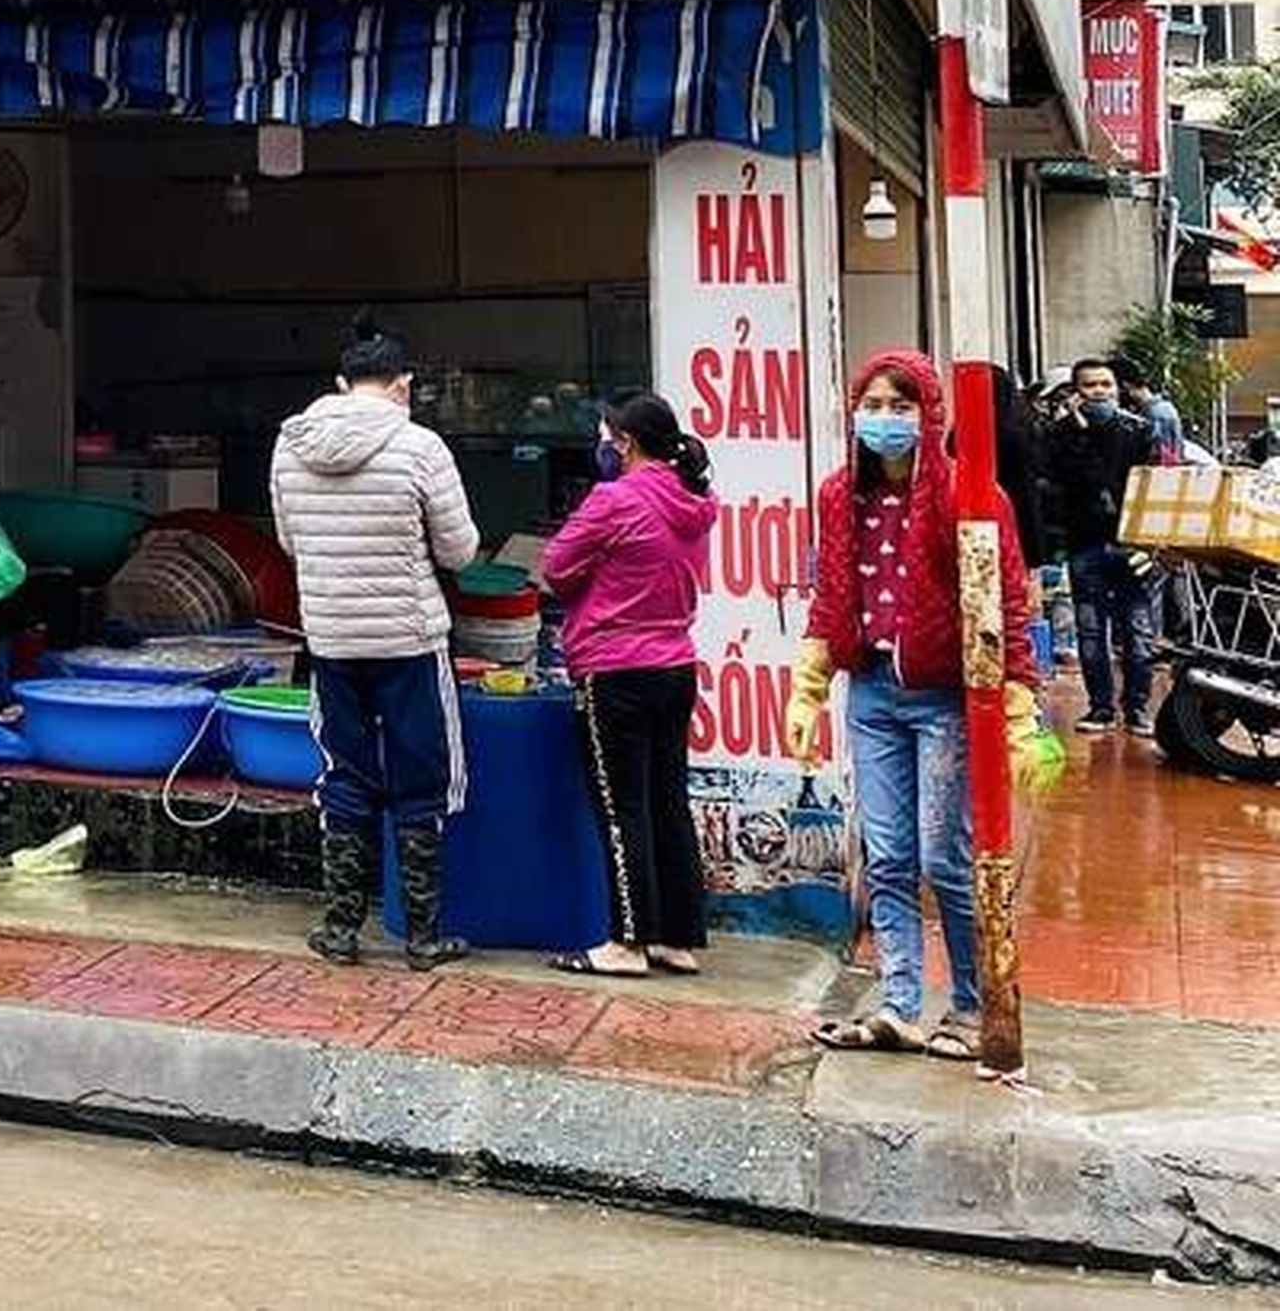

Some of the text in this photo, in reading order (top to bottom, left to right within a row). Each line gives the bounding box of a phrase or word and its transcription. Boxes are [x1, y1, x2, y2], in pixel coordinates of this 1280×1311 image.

[696, 161, 787, 285] HẢI
[689, 316, 804, 441] SẢN
[700, 495, 812, 600] ƯƠI
[689, 628, 833, 762] SỐN
